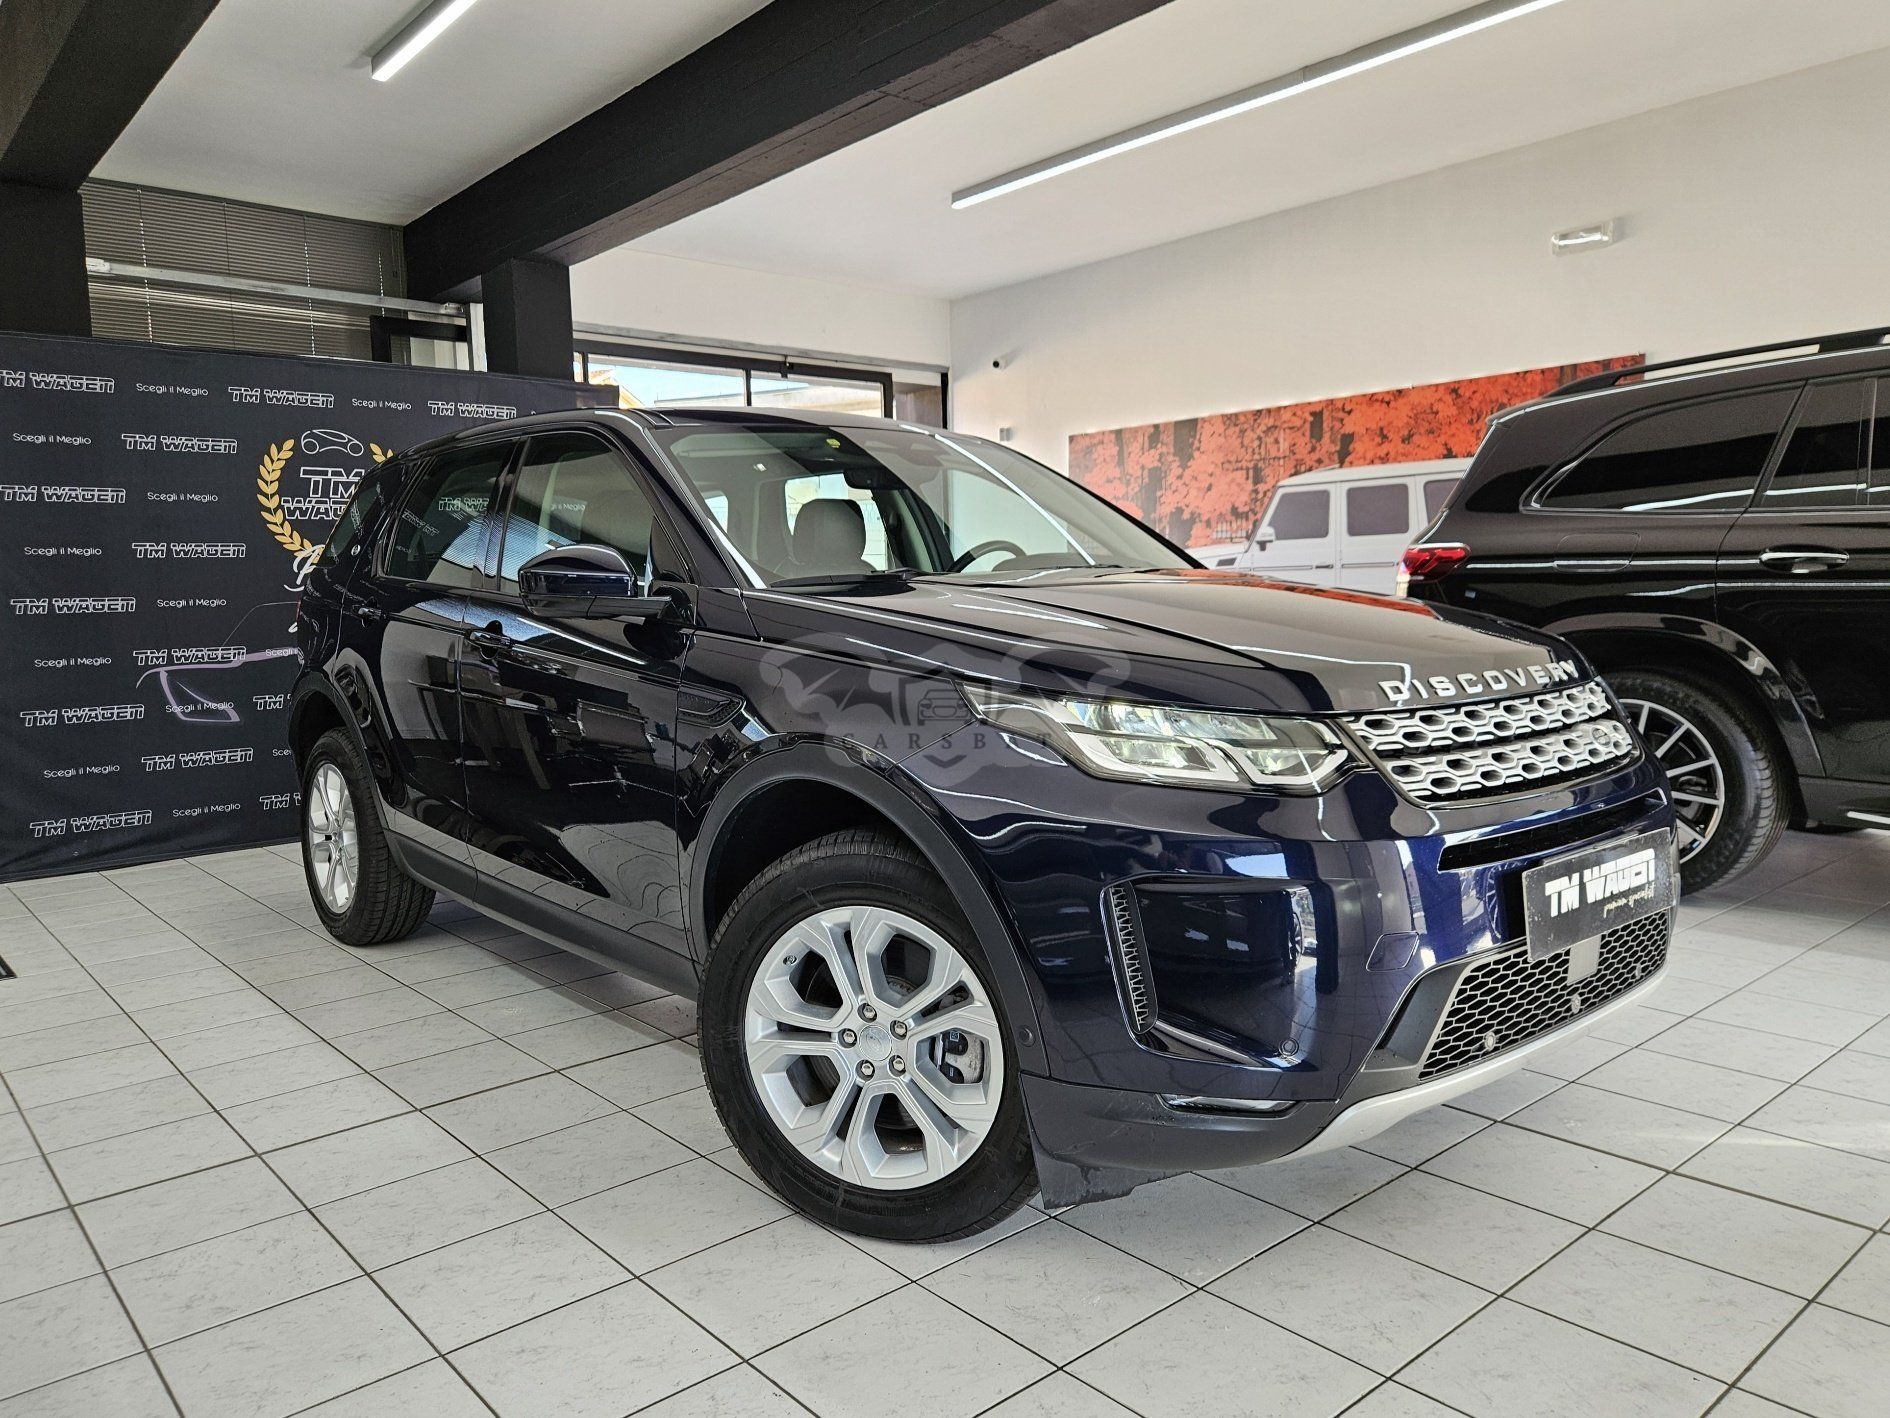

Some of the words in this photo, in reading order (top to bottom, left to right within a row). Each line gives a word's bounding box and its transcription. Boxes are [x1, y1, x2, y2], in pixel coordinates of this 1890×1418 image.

[0, 369, 26, 388] M
[29, 371, 115, 394] WAGEN
[136, 382, 167, 394] Scegli
[169, 385, 175, 393] il
[176, 386, 209, 397] Meglio
[228, 386, 261, 404] TM
[264, 388, 335, 409] WAGEN
[351, 398, 378, 409] Scegli
[379, 400, 383, 408] il
[384, 401, 412, 411] Meglio
[427, 400, 455, 416] TM
[457, 402, 517, 420] WAGEN
[12, 432, 47, 444] Scegli
[49, 434, 54, 443] il
[56, 435, 92, 446] Meglio
[121, 433, 157, 451] TM
[160, 435, 238, 454] WAGEN
[299, 466, 365, 499] TM
[0, 484, 38, 502] TM
[41, 485, 126, 504] WAGEN
[147, 491, 178, 502] Scegli
[179, 493, 185, 501] il
[186, 493, 219, 503] Meglio
[281, 497, 352, 520] WAG
[24, 546, 58, 557] Scegli
[60, 546, 65, 555] il
[67, 547, 103, 557] Meglio
[131, 542, 167, 559] TM
[170, 542, 247, 559] WAGEN
[10, 597, 49, 615] TM
[52, 596, 137, 614] WAGEN
[156, 599, 187, 609] Scegli
[189, 598, 194, 607] il
[195, 598, 227, 608] Meglio
[34, 658, 68, 668] Scegli
[69, 657, 75, 666] il
[77, 656, 112, 667] Meglio
[133, 648, 168, 666] TM
[171, 645, 247, 665] WAGEN
[1377, 659, 1580, 702] DISCOVERY
[252, 693, 285, 711] TM
[20, 709, 58, 727] TM
[61, 703, 145, 724] WAGEN
[141, 753, 176, 772] TM
[179, 747, 254, 768] WAGEN
[272, 748, 292, 757] Sce
[43, 767, 77, 779] Scegli
[79, 767, 84, 775] il
[86, 764, 121, 774] Meglio
[172, 807, 202, 818] Scegli
[204, 806, 209, 814] il
[210, 802, 241, 813] Meglio
[259, 793, 291, 811] TM
[29, 818, 67, 838] TM
[70, 809, 153, 833] WAGEN
[1544, 871, 1580, 918] TM
